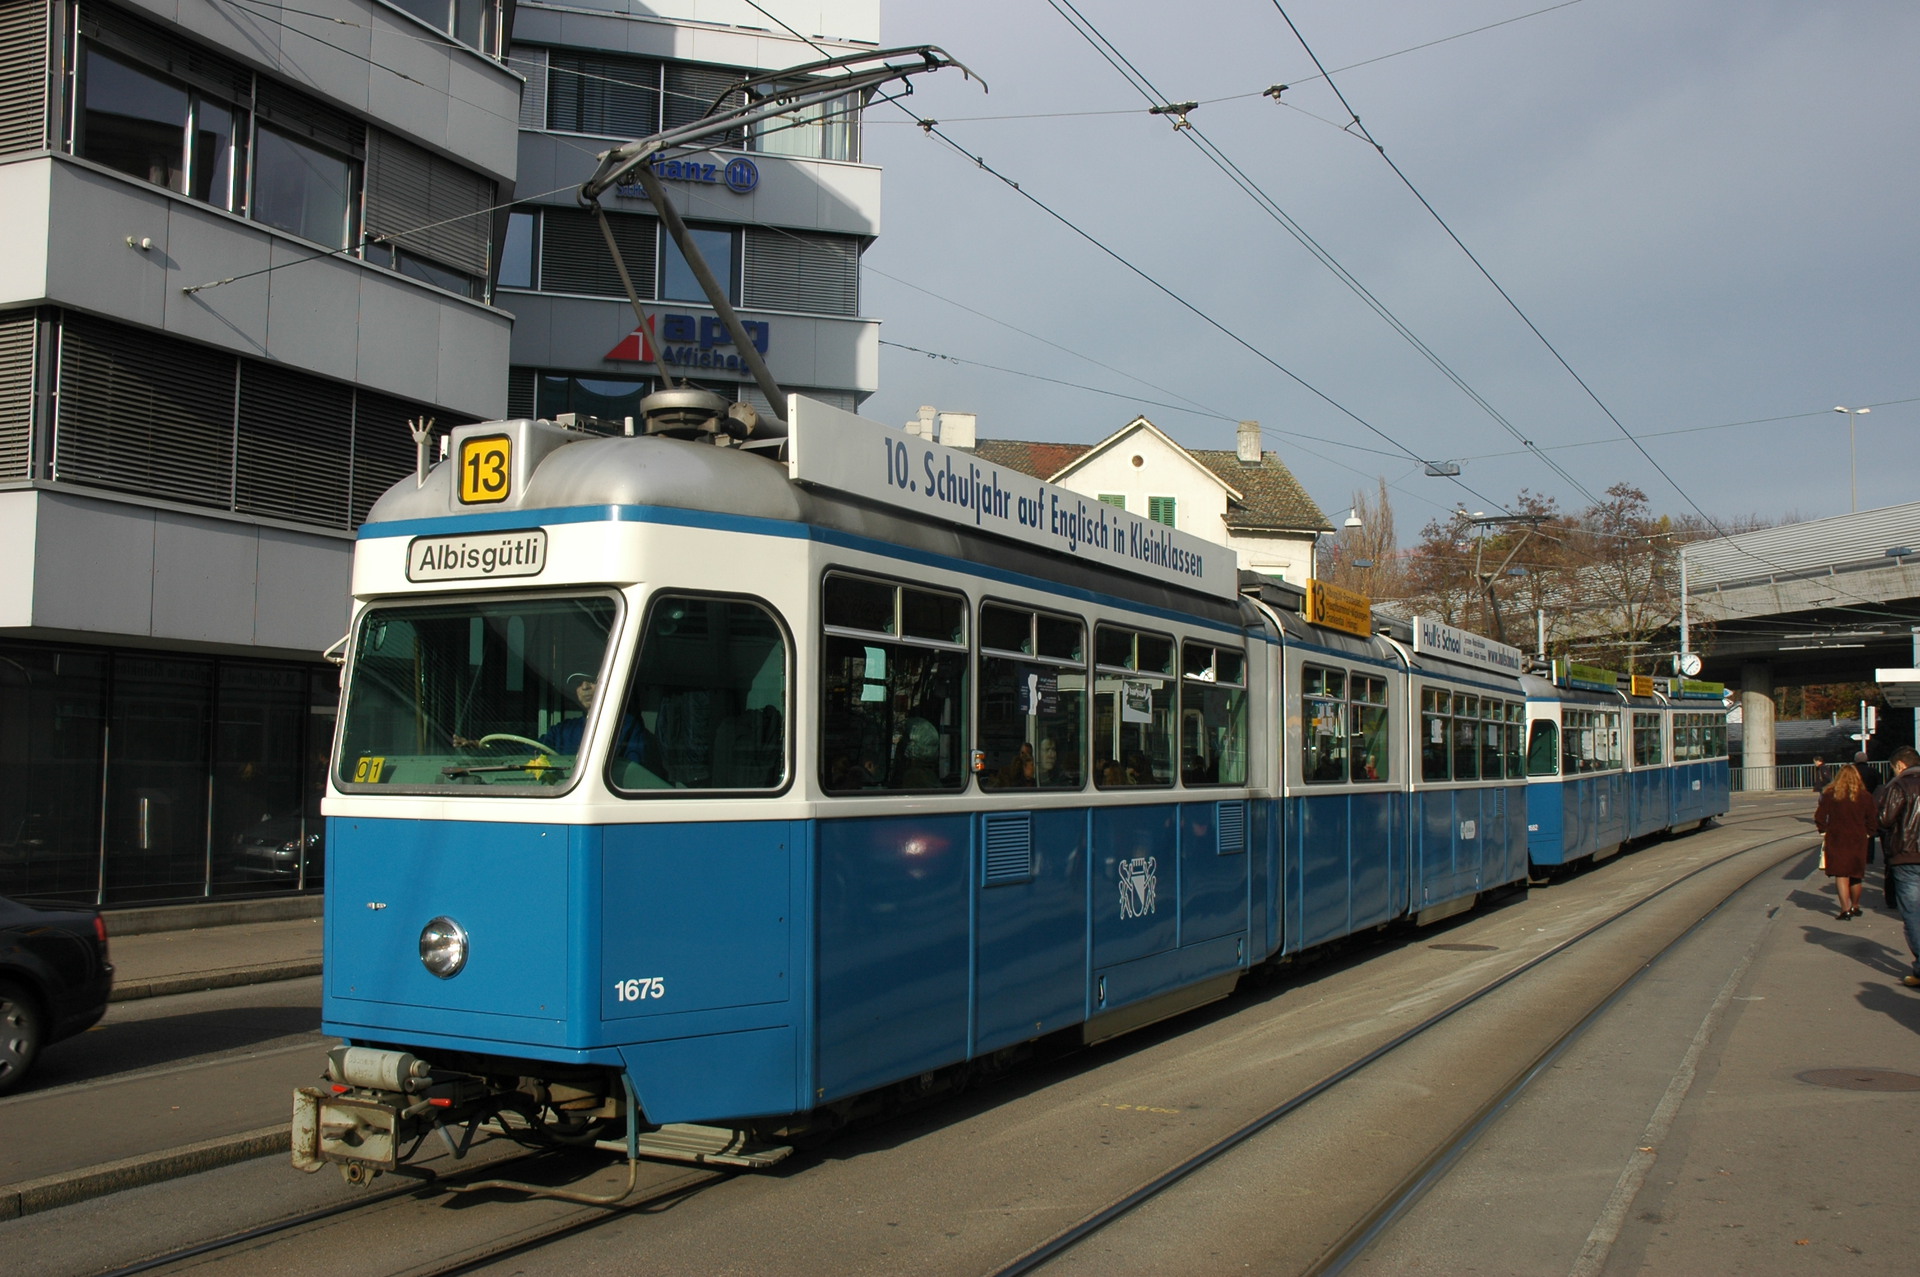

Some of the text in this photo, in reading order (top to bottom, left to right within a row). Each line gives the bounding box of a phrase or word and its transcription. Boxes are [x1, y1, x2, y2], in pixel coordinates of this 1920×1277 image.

[664, 313, 769, 354] apg
[662, 345, 766, 376] Affichag
[467, 450, 506, 494] 13
[884, 436, 1203, 578] 10. Schuljahr auf Englisch in Kleinklassen
[418, 537, 538, 574] Albisgütli
[357, 761, 380, 779] 01
[614, 976, 665, 1002] 1675
